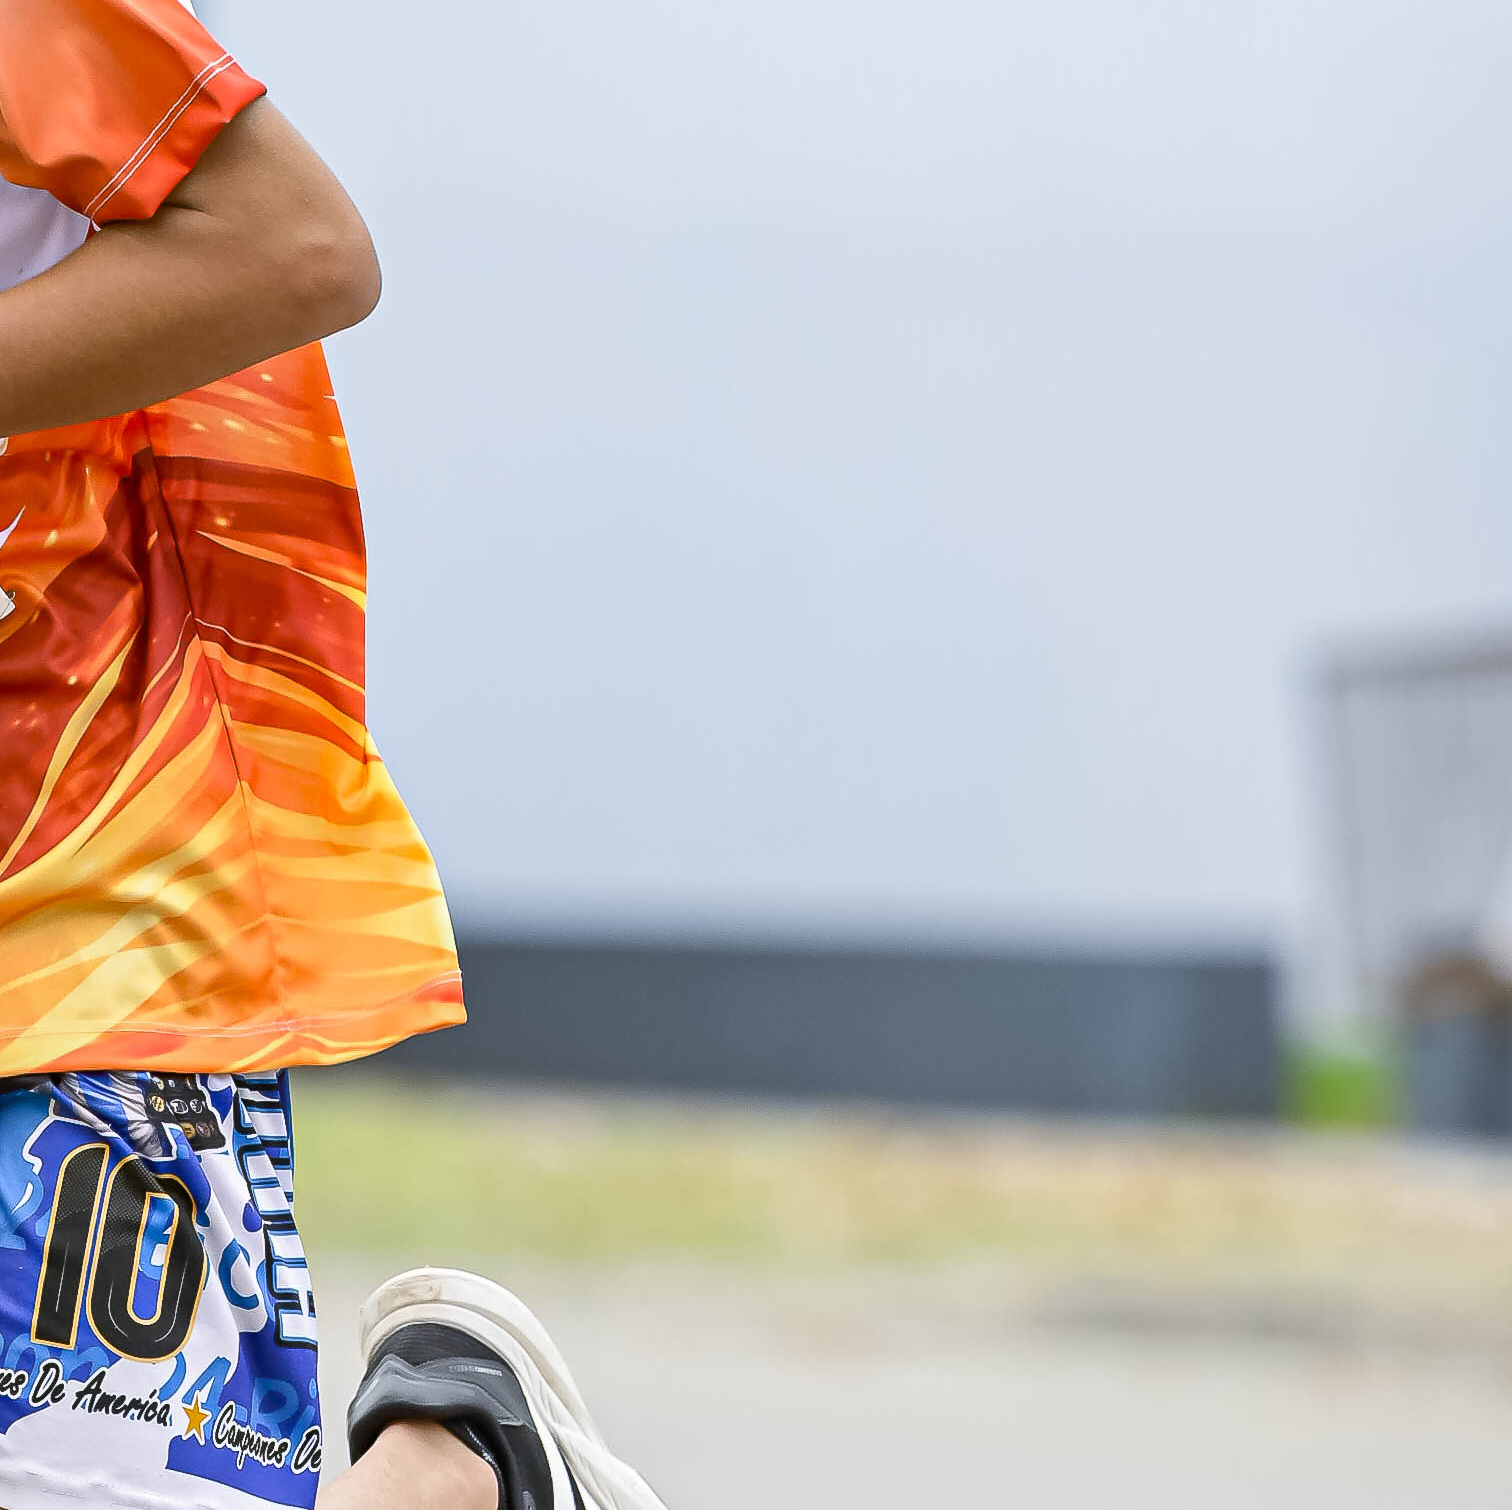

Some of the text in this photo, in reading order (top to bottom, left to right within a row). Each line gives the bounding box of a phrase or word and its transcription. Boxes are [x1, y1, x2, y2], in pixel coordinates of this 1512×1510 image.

[31, 1142, 207, 1362] 10
[31, 1362, 66, 1404] De
[214, 1404, 289, 1467] Campeones
[293, 1429, 322, 1471] De
